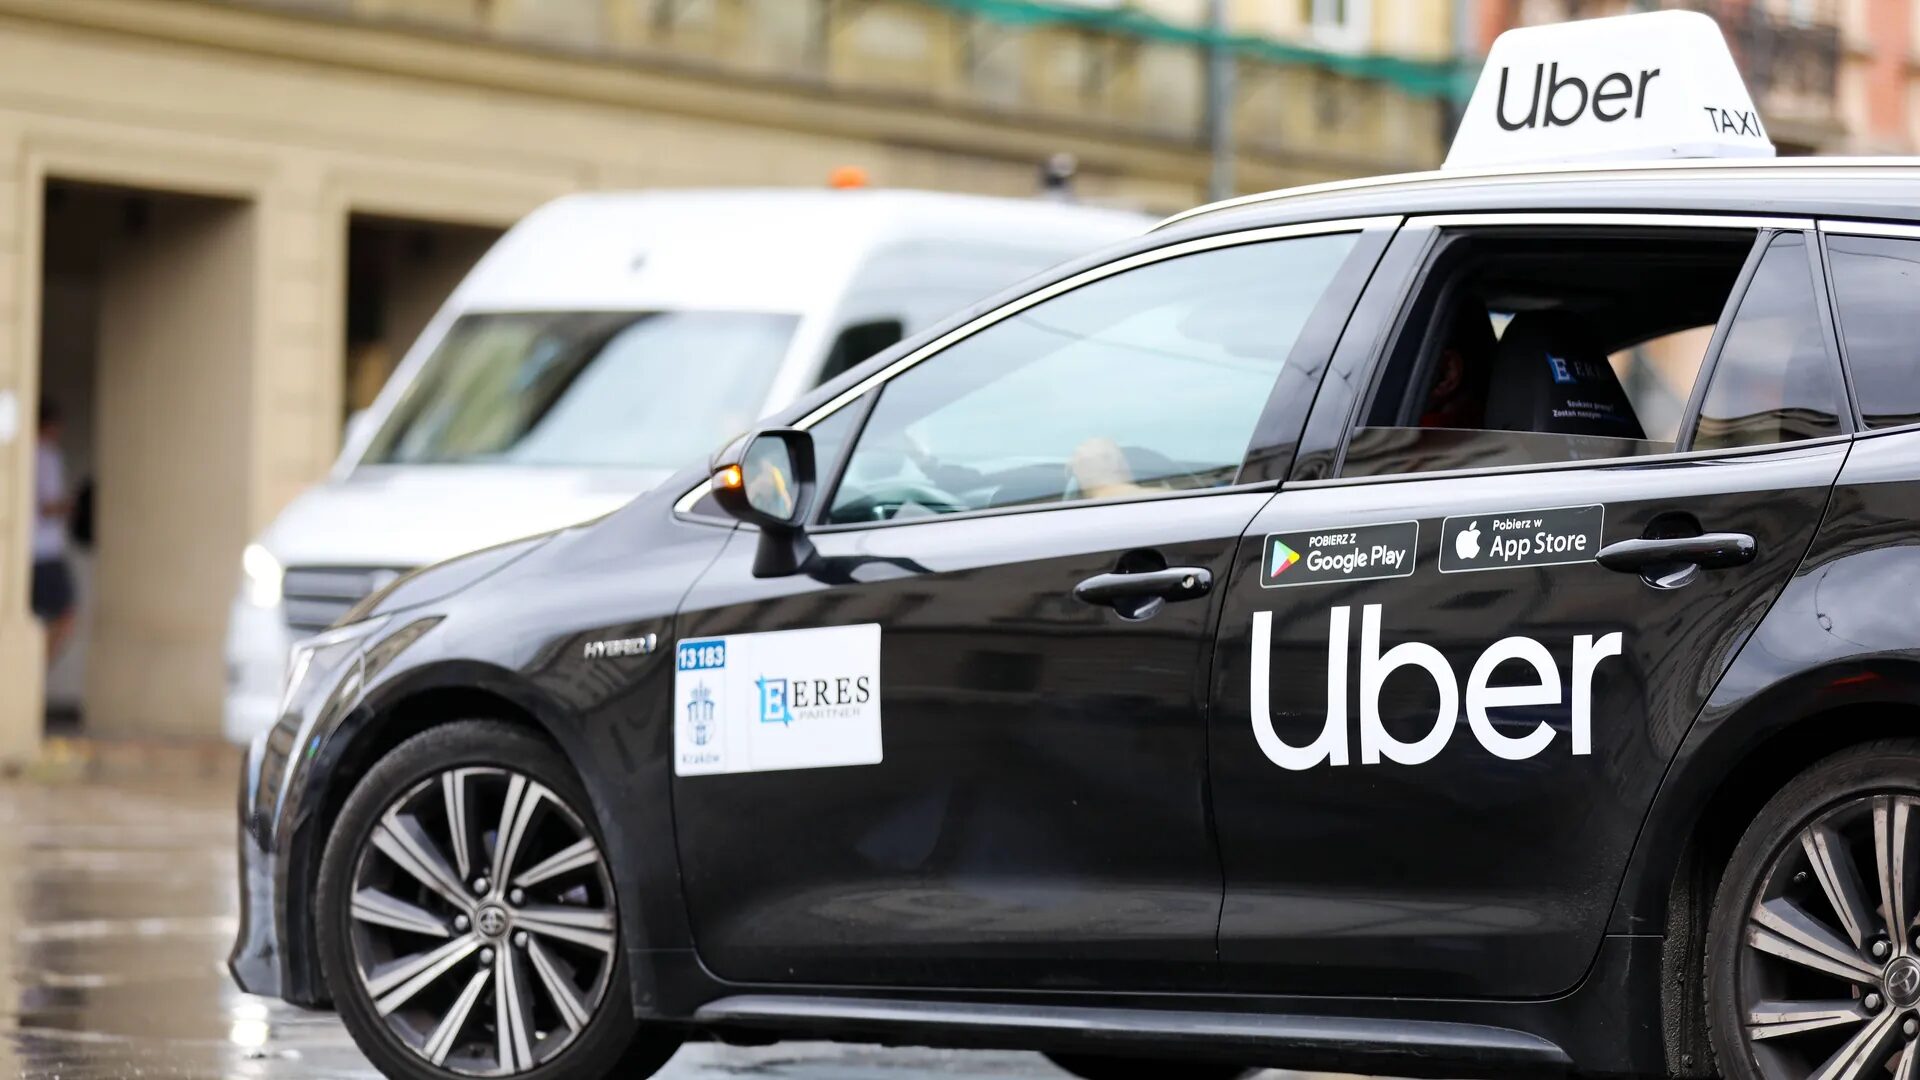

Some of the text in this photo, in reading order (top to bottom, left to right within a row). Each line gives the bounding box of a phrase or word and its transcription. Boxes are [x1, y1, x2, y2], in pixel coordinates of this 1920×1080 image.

[1497, 62, 1660, 131] Uber
[1703, 106, 1762, 138] TAXI
[1309, 533, 1357, 547] POBIERZ Z
[1492, 518, 1543, 531] Pobierz w
[1306, 545, 1406, 574] Google Play
[1489, 531, 1587, 562] App Store
[678, 645, 725, 669] 13183
[793, 676, 870, 708] ERES
[1250, 603, 1622, 771] Uber
